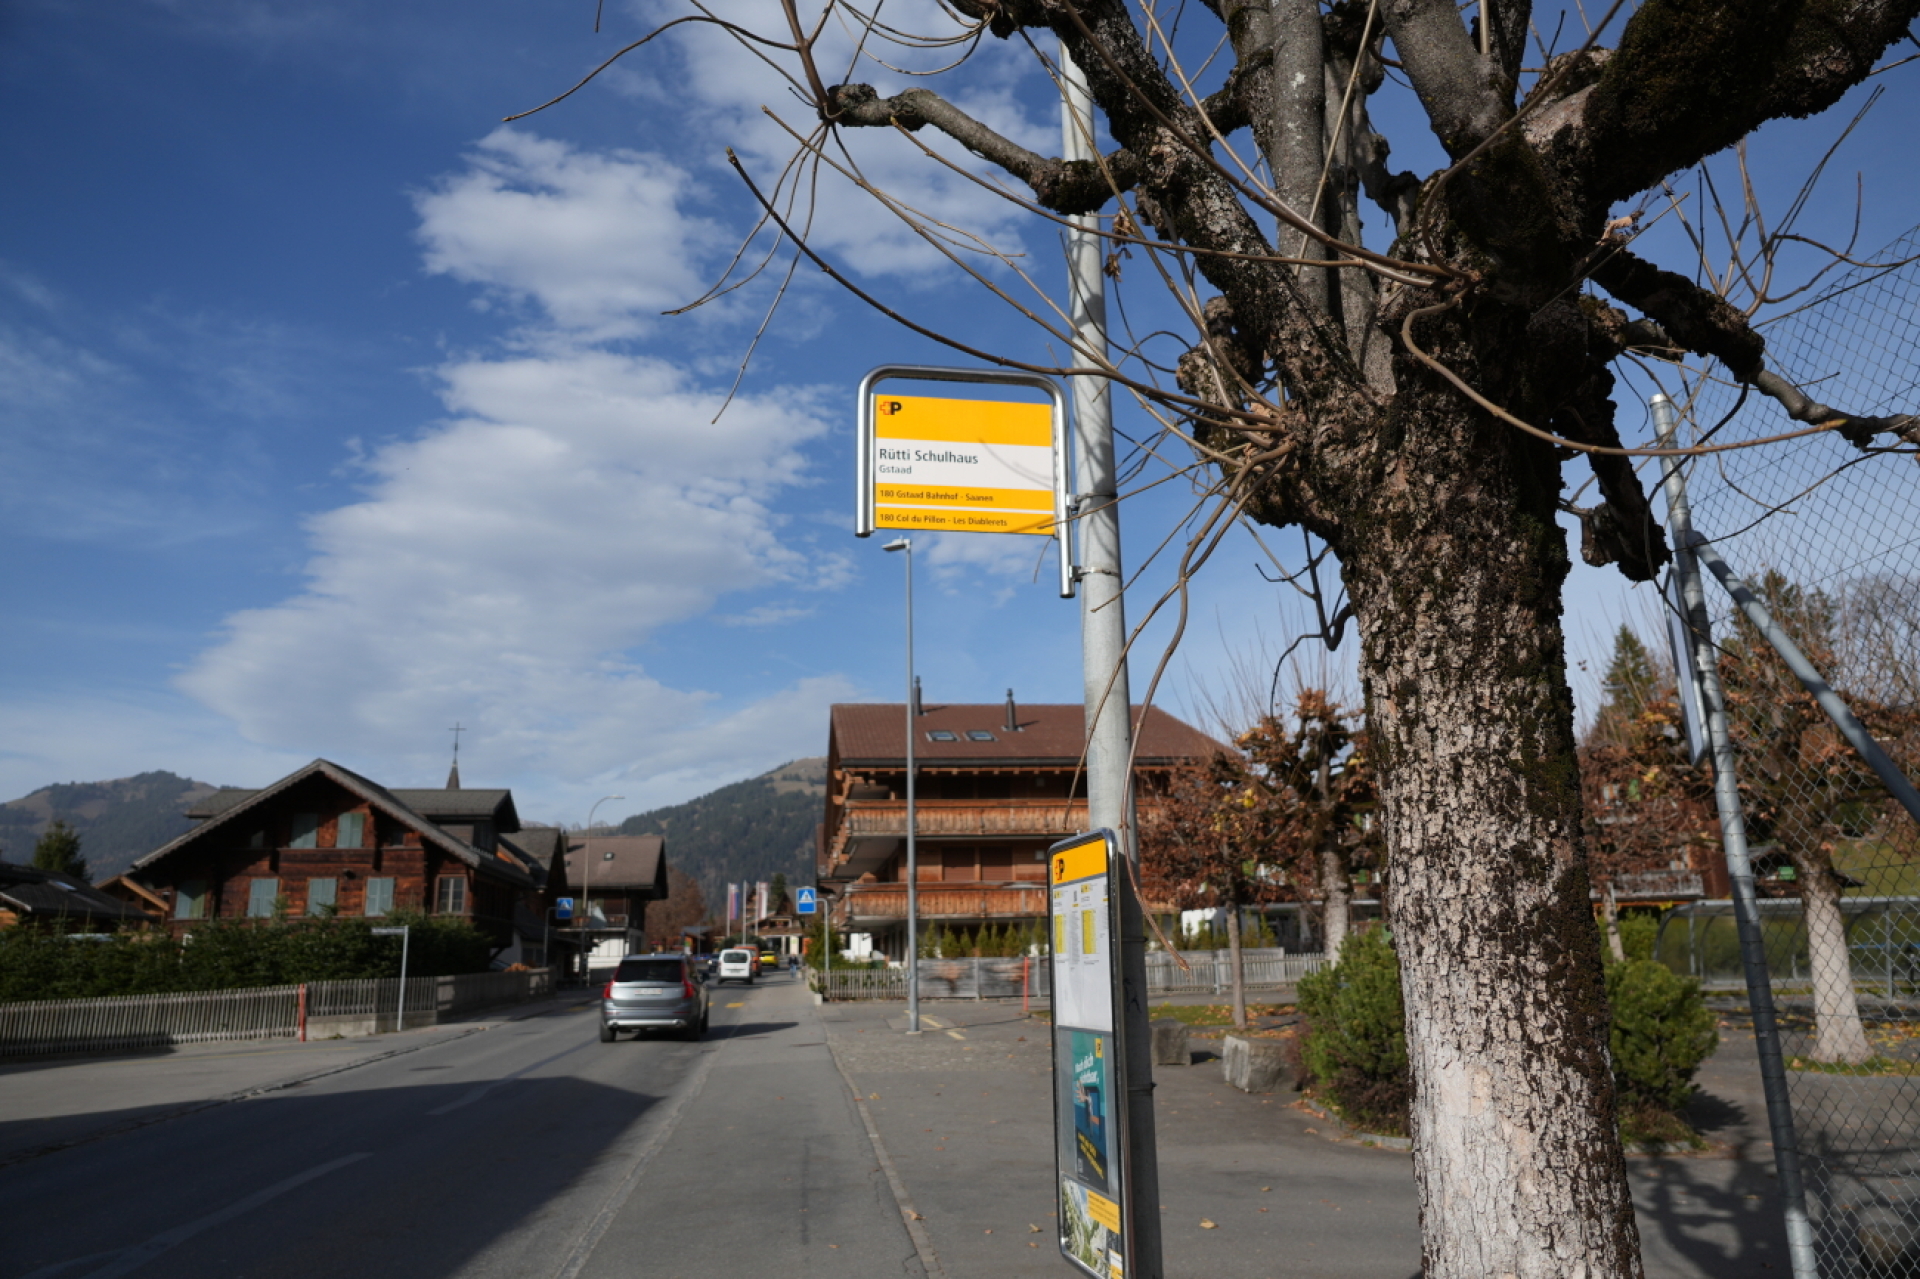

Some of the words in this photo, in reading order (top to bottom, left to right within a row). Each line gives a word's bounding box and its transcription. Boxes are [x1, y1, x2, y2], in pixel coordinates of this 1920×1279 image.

[879, 448, 911, 461] Rütti
[915, 450, 979, 465] Schulhaus
[879, 464, 912, 474] Gstaad
[880, 489, 894, 498] 180
[896, 490, 924, 499] Gstaad
[926, 491, 958, 500] Bahnhof
[966, 493, 993, 502] Saanen
[880, 513, 894, 522] 180
[896, 514, 909, 522] Col
[911, 515, 922, 523] du
[924, 515, 946, 524] Pillon
[954, 517, 966, 525] Les
[969, 517, 1007, 527] Diablerets
